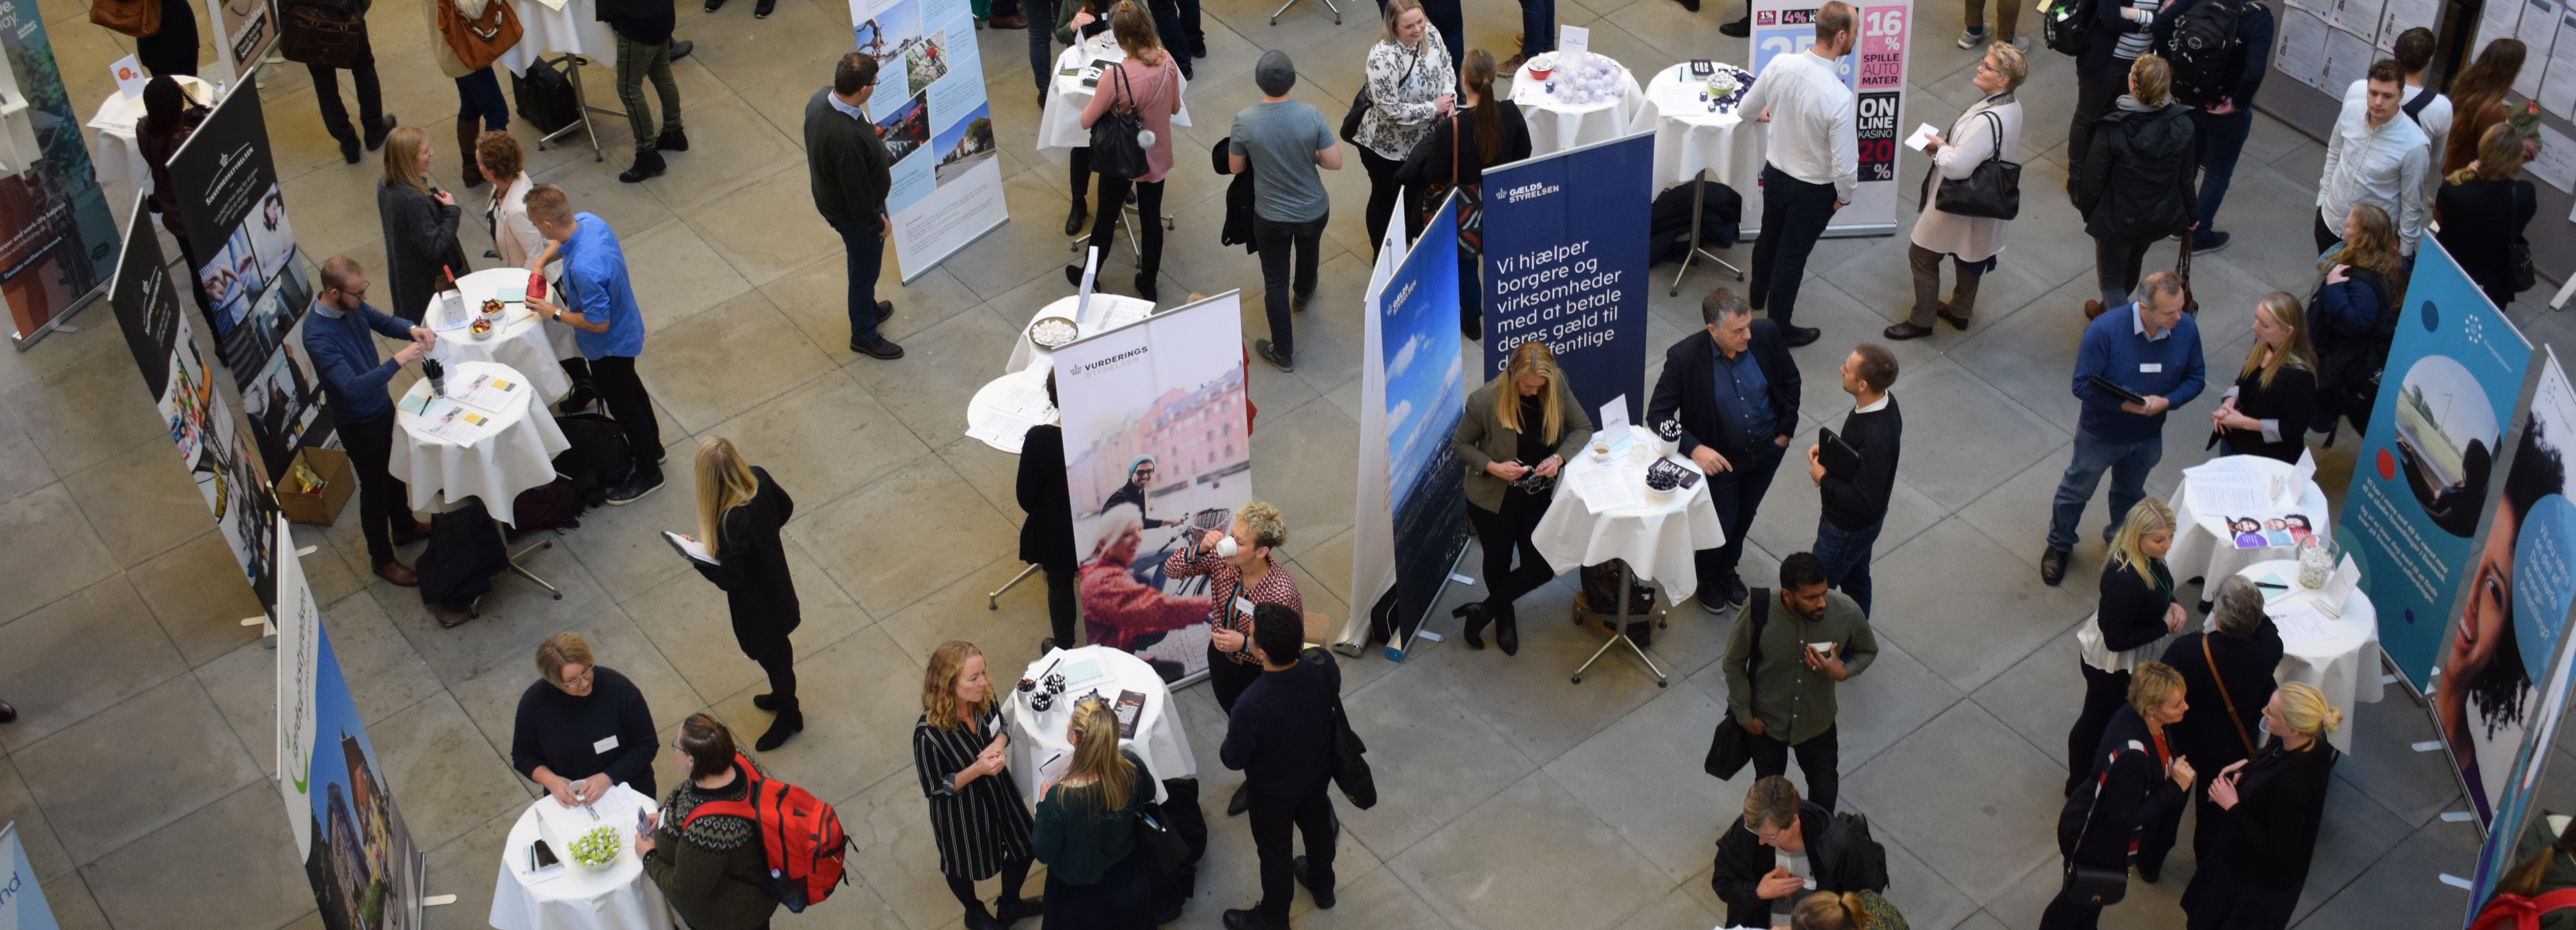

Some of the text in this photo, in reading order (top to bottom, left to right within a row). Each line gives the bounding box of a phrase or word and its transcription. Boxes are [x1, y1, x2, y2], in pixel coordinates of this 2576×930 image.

[230, 1, 267, 48] Middelfart
[1784, 11, 1807, 23] 4%
[1867, 10, 1902, 36] 16
[1885, 36, 1900, 51] %
[1862, 63, 1899, 76] AUTO
[1863, 54, 1899, 63] SPILLE
[1862, 76, 1898, 85] MATER
[1859, 97, 1895, 118] ON
[1858, 129, 1893, 139] KASINO
[1859, 117, 1894, 129] LINE
[1858, 139, 1893, 163] 20
[206, 146, 254, 206] SIKKERHEDSSTYRELSEN
[1874, 163, 1891, 179] %
[1509, 182, 1542, 196] GÆLDS
[1510, 185, 1559, 203] STYRELSEN
[0, 239, 13, 252] areer
[1497, 240, 1589, 274] Vi hjælper
[1498, 258, 1597, 294] borgere og
[1393, 283, 1408, 308] GÆLDS
[1394, 279, 1416, 315] STYRELSEN
[1497, 270, 1622, 313] virksomheder
[1498, 288, 1621, 333] med at betale
[1498, 305, 1617, 352] deres gæld til
[1545, 329, 1614, 355] fentlige
[1084, 346, 1148, 371] VURDERINGS
[1085, 356, 1139, 379] STYRELSEN
[2535, 538, 2560, 587] en del af
[2540, 520, 2570, 586] Vil du være
[2530, 549, 2556, 610] Danmarks
[0, 871, 21, 905] nd
